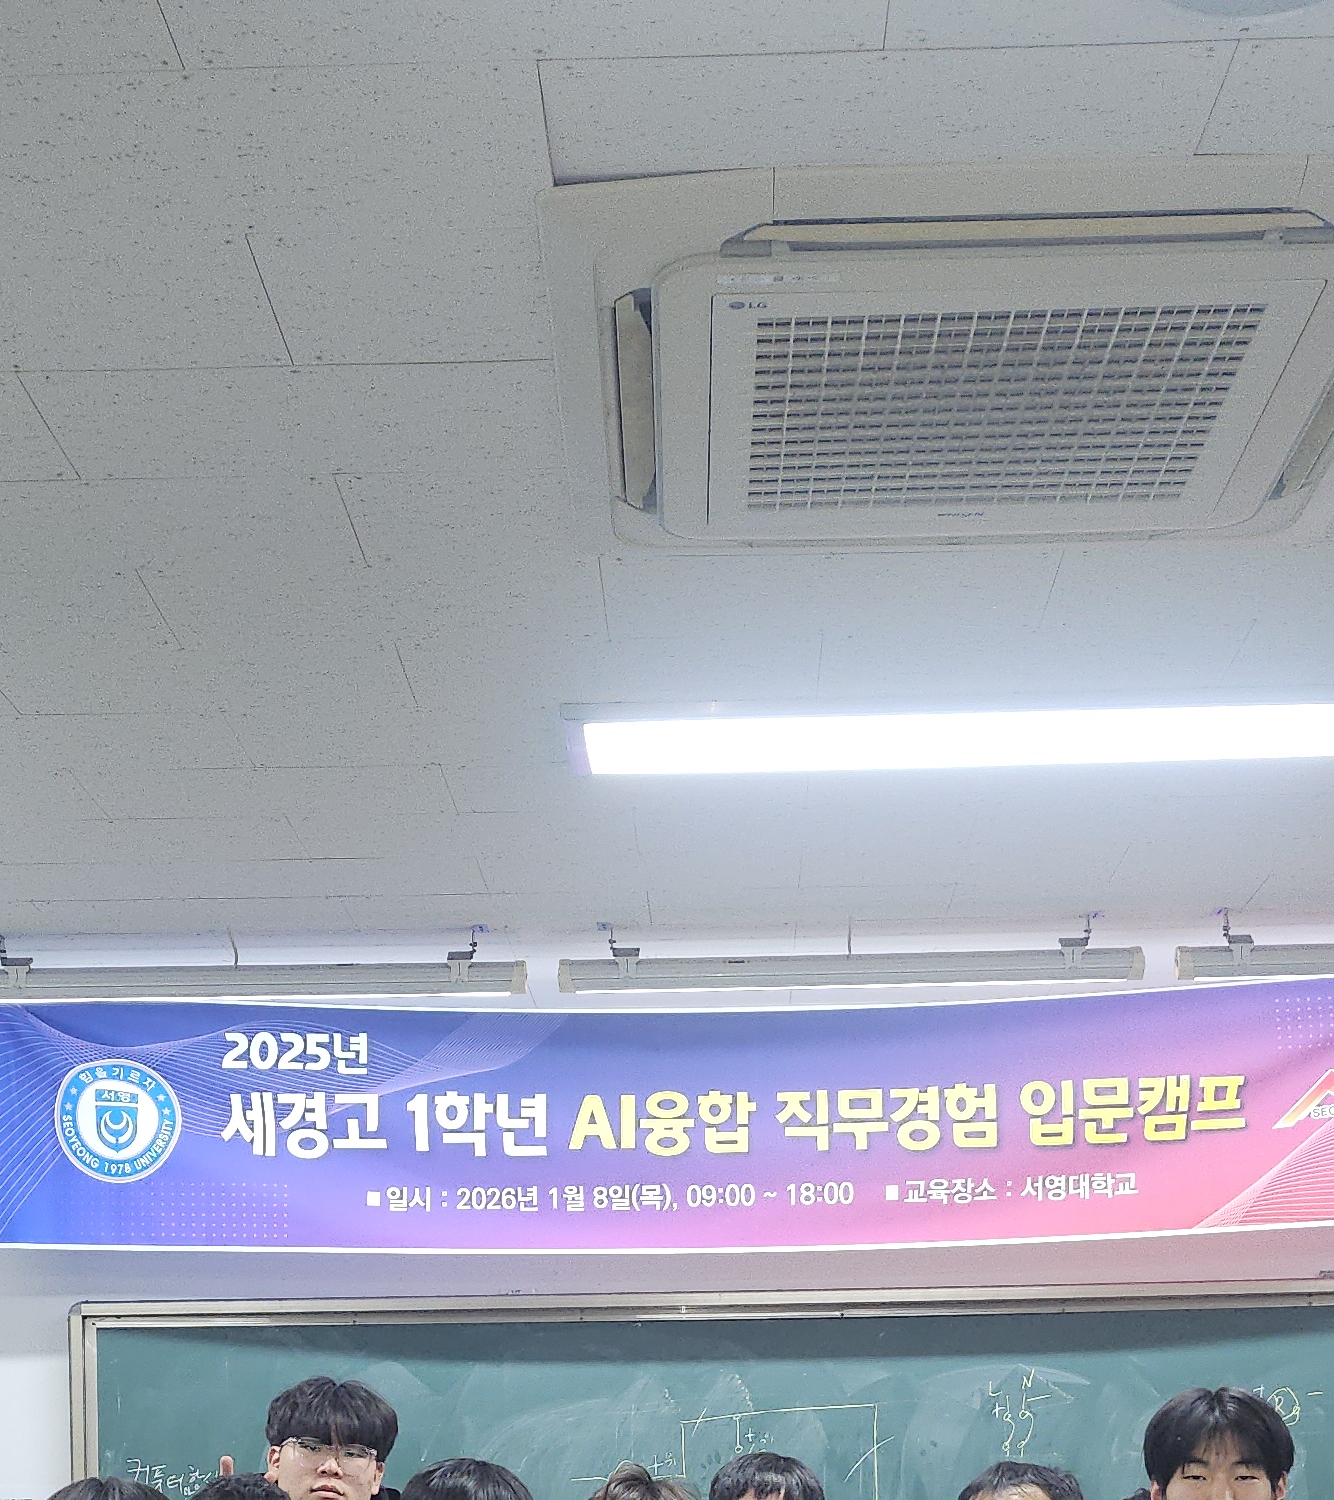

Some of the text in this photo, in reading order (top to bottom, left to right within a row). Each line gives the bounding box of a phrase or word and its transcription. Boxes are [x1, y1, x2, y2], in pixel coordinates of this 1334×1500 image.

[221, 1032, 368, 1075] 2025년
[102, 1091, 131, 1103] 서영
[221, 1075, 1246, 1160] 세경고 1학년 AI융합 직무경험 입문캠프
[62, 1114, 174, 1175] SEOYEONG 1978 UNIVERSITY
[386, 1186, 432, 1213] 일시
[456, 1185, 539, 1212] 2026년
[548, 1184, 585, 1212] 1월
[593, 1183, 678, 1213] 8일(목),
[686, 1183, 756, 1208] 09:00
[785, 1182, 855, 1206] 18:00
[903, 1177, 997, 1206] 교육장소
[1020, 1172, 1138, 1202] 서영대학교
